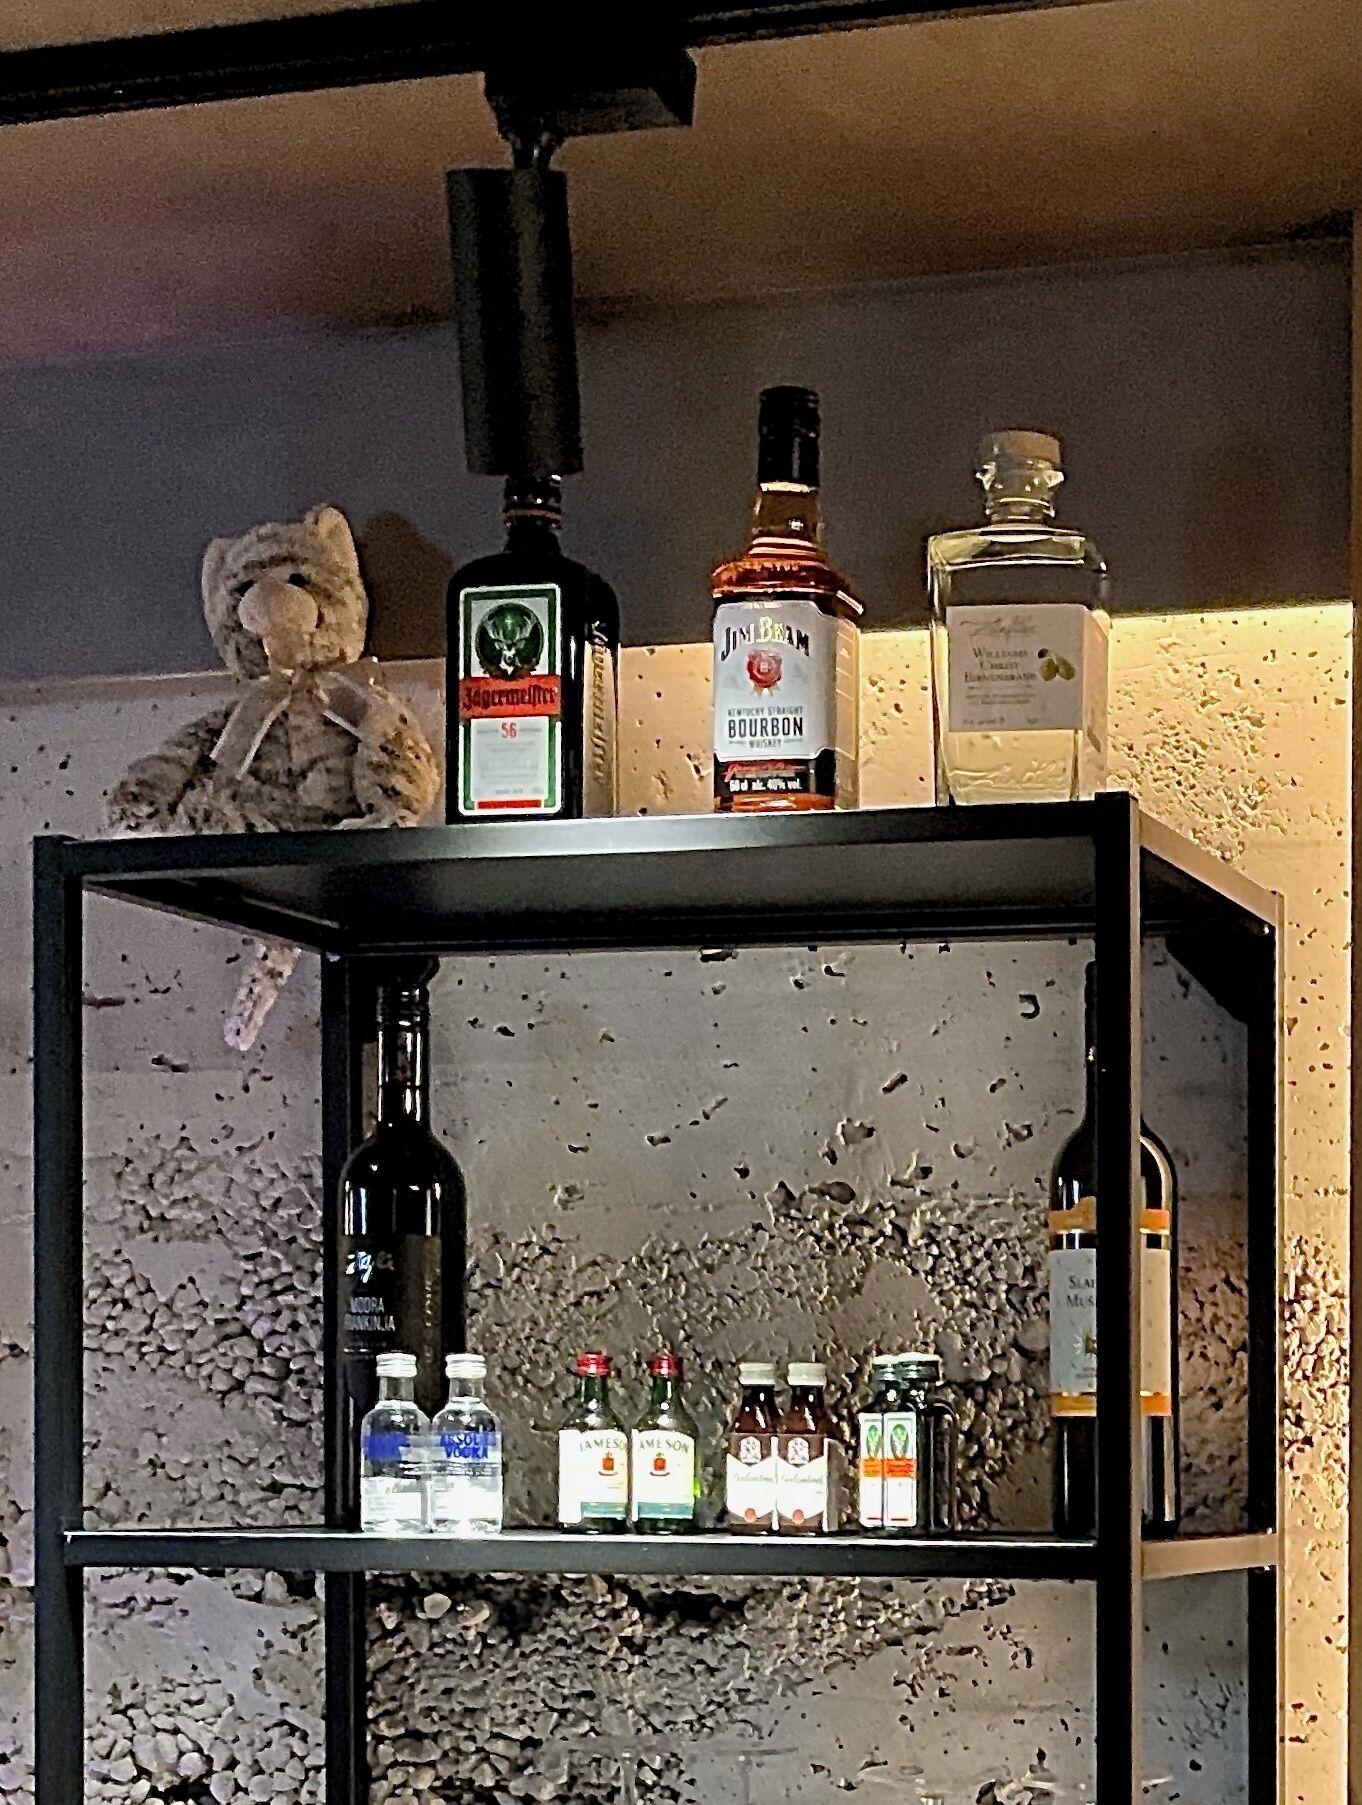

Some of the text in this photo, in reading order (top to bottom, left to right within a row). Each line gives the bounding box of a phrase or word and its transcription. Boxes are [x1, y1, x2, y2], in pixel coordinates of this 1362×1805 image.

[720, 616, 810, 662] JIM BEAM
[728, 706, 804, 717] KENTUCKY STRAIGHT
[501, 722, 517, 738] 56
[728, 717, 803, 738] BOURBON
[749, 739, 782, 749] WHISKEY
